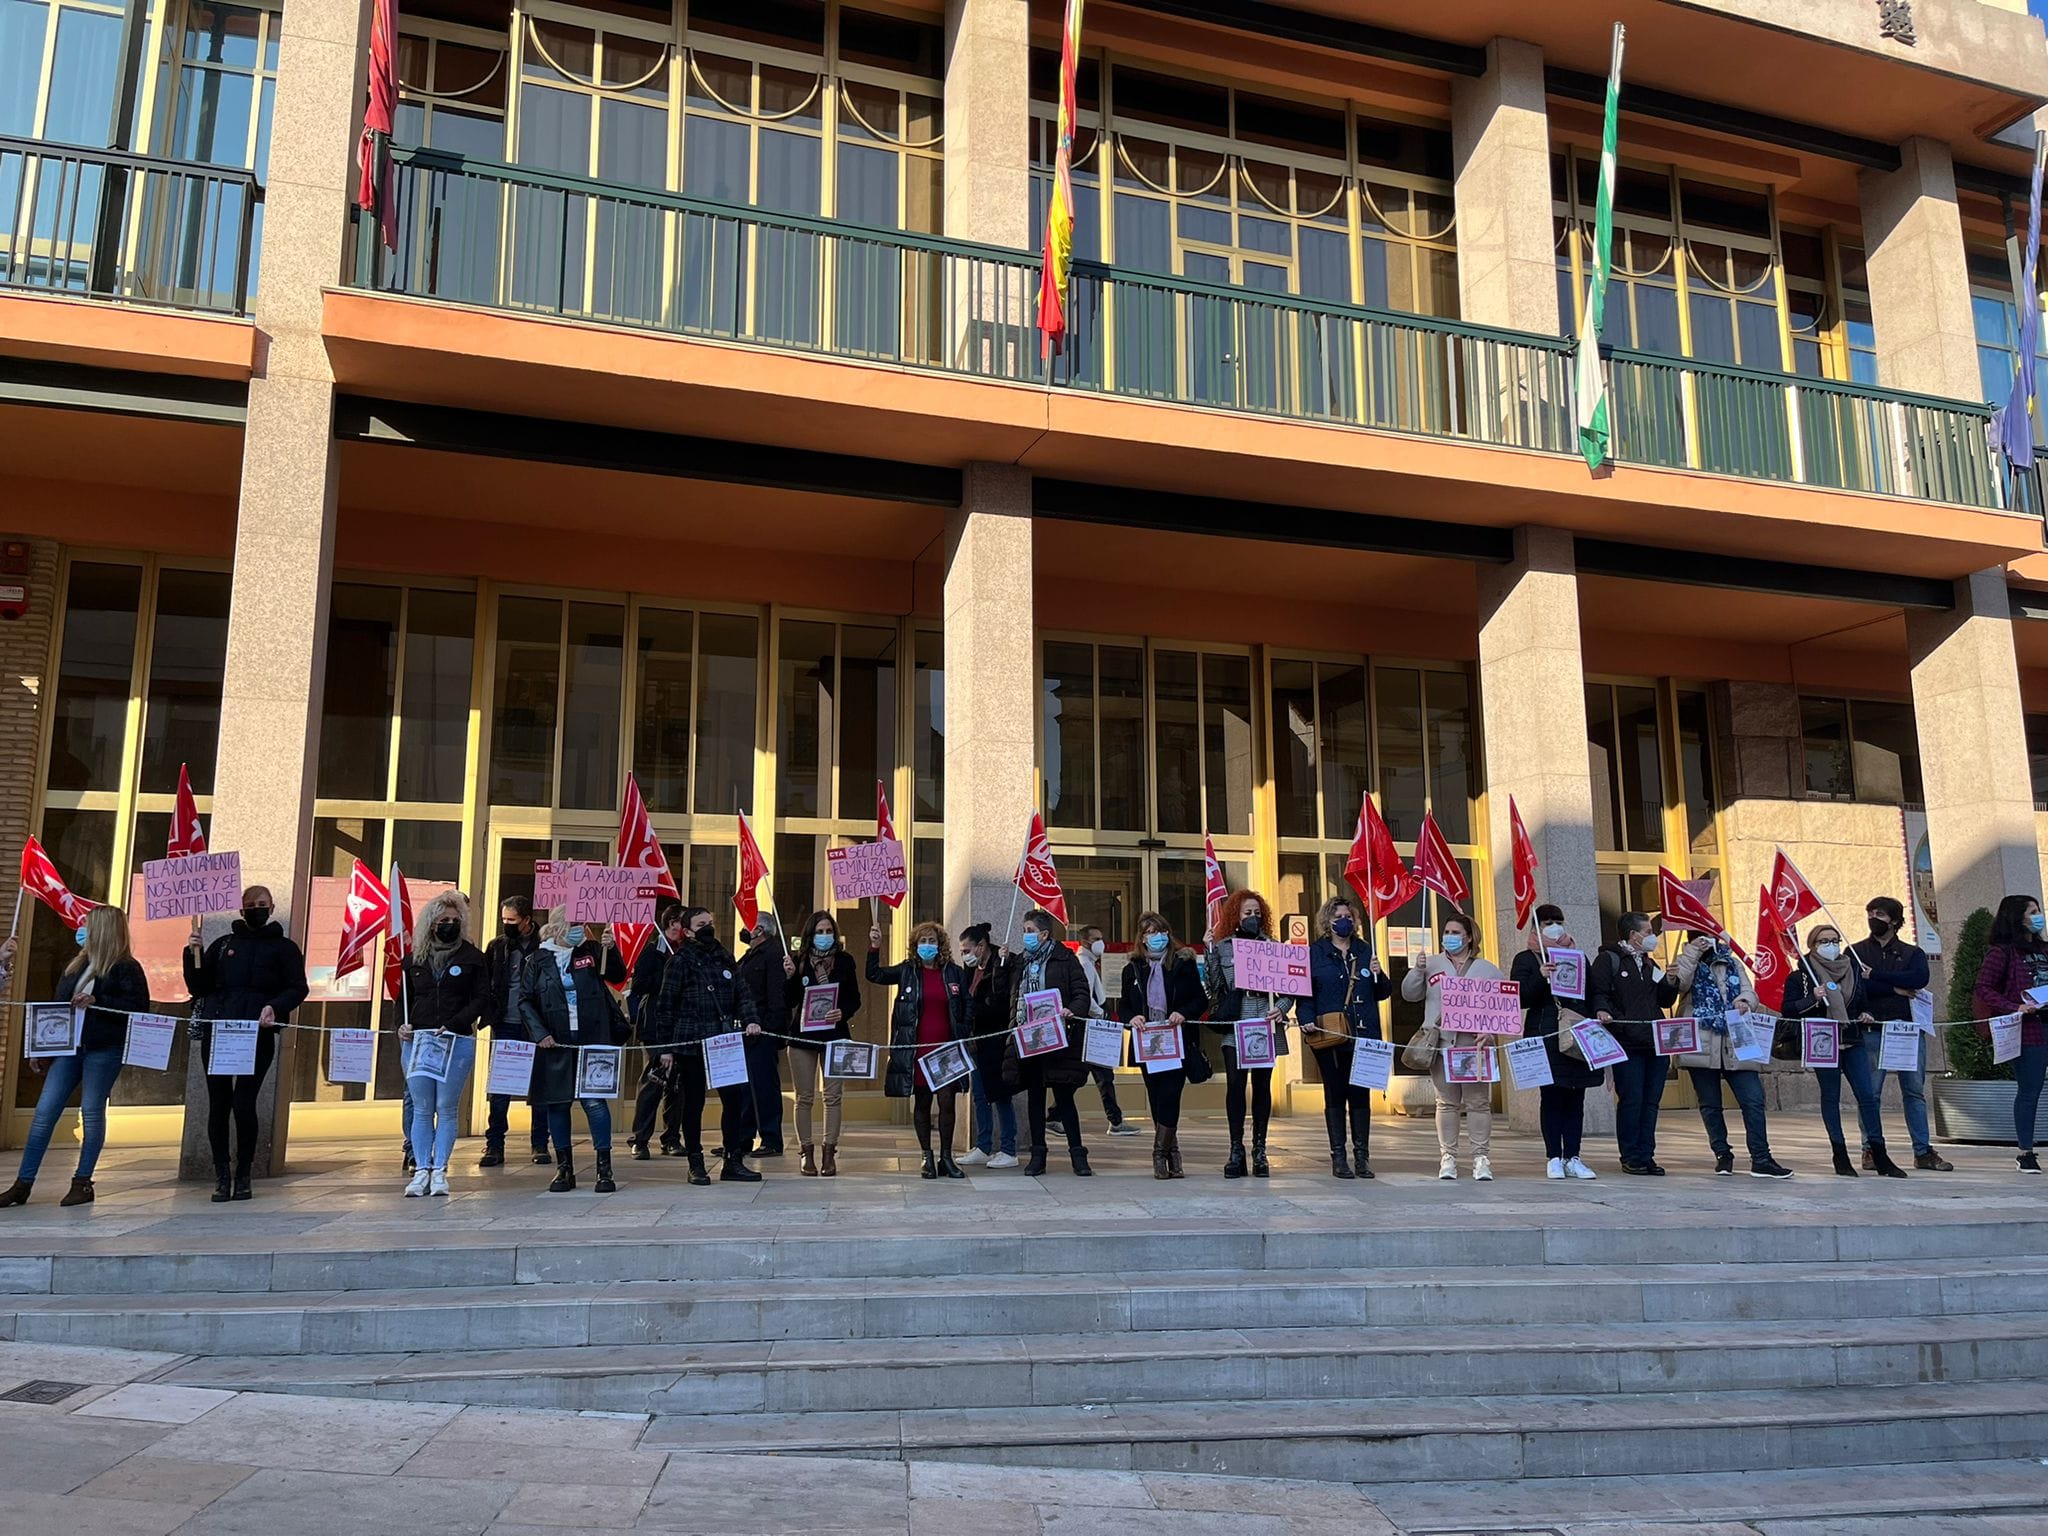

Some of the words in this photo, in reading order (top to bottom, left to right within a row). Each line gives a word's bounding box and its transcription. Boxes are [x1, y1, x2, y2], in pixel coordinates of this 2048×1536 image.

[848, 843, 888, 859] SECTOR
[146, 862, 159, 880] EL
[161, 852, 239, 878] AYUNTAMIENTO
[573, 868, 591, 882] LA
[596, 868, 634, 884] AYUDA
[639, 871, 651, 884] A
[832, 855, 901, 876] FEMINIZADO
[147, 881, 172, 898] NOS
[173, 877, 208, 896] VENDE
[212, 875, 220, 892] Y
[222, 874, 238, 890] SE
[850, 870, 887, 883] SECTOR
[579, 886, 638, 901] DOMICILIO
[835, 879, 906, 900] PRECARIZADO
[148, 892, 234, 920] DESENTIENDE
[534, 892, 549, 909] NO
[575, 901, 597, 922] EN
[603, 902, 654, 923] VENTA
[1236, 940, 1307, 961] ESTABILIDAD
[1246, 957, 1262, 972] EN
[1268, 960, 1286, 974] EL
[1248, 973, 1299, 994] EMPLEO
[1441, 977, 1458, 991] LOS
[1442, 994, 1487, 1009] SOCIALES
[1488, 997, 1519, 1012] OLVIDA
[1442, 1012, 1451, 1029] A
[1452, 1012, 1473, 1030] SUS
[1474, 1014, 1522, 1034] MAYORES
